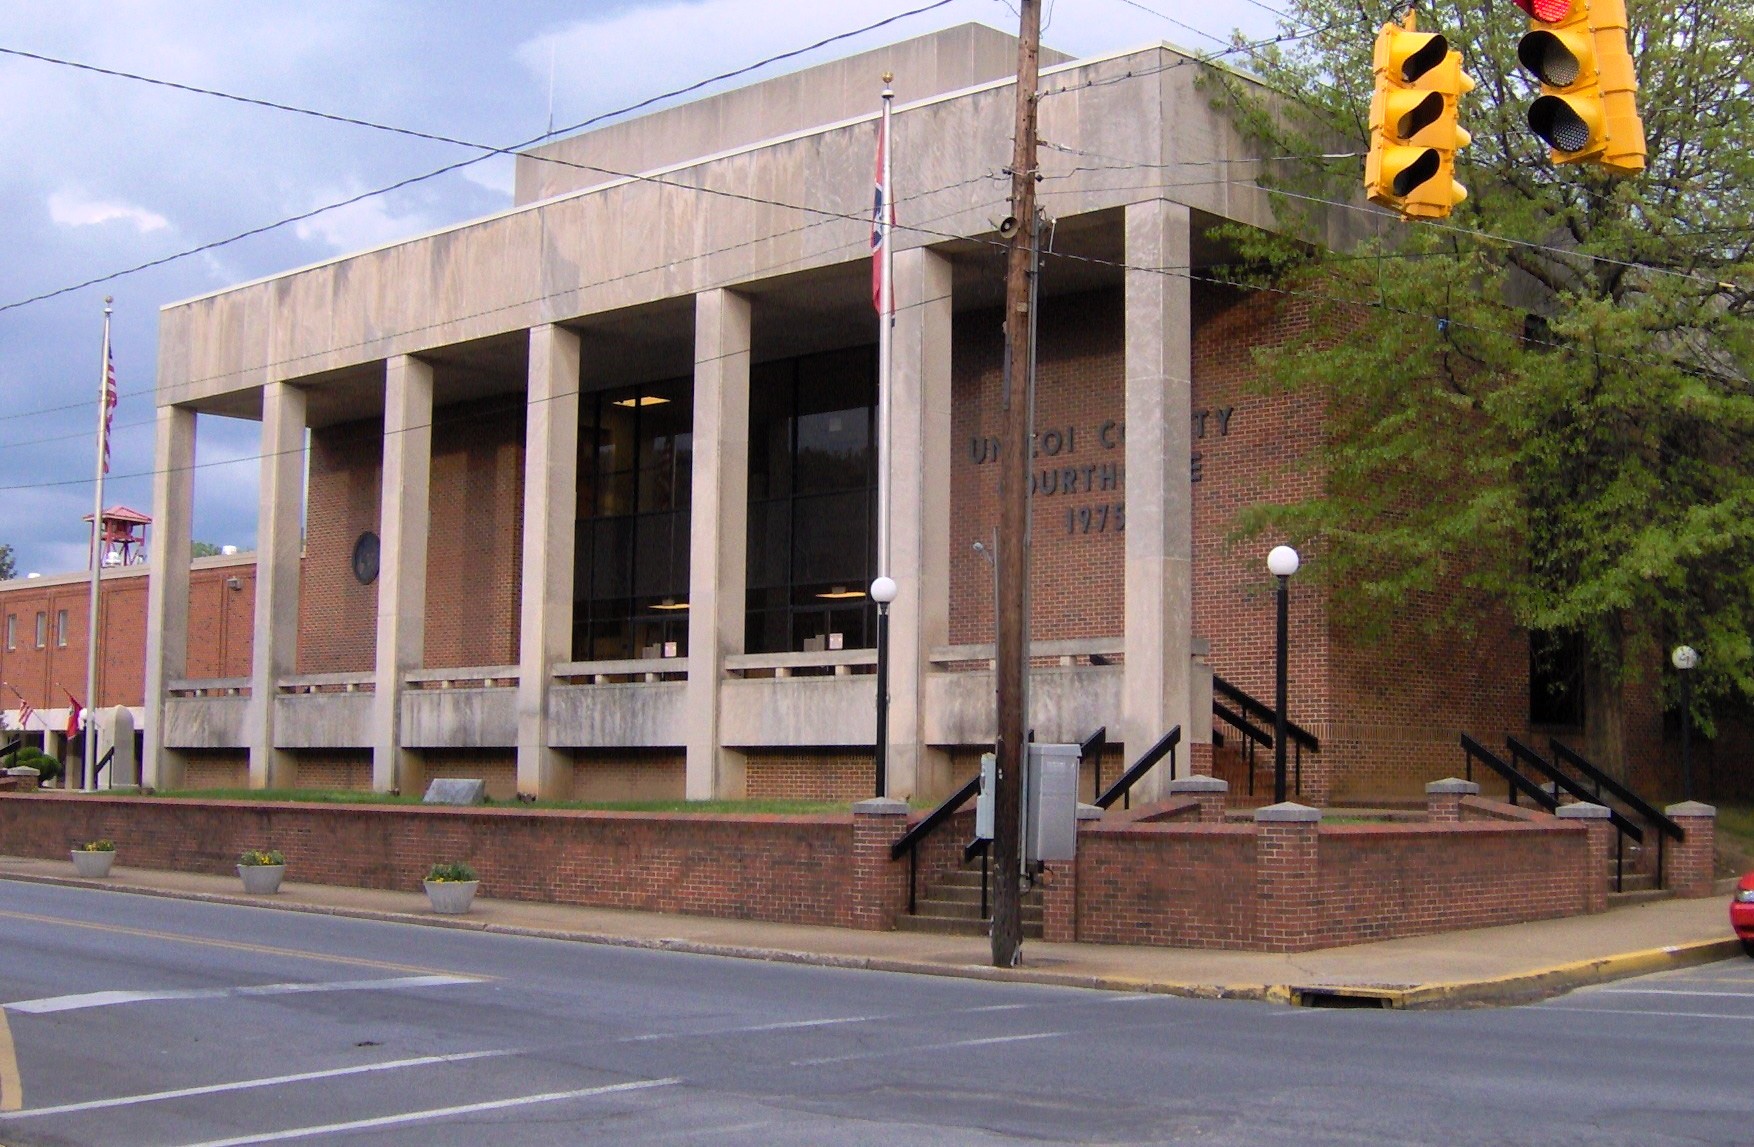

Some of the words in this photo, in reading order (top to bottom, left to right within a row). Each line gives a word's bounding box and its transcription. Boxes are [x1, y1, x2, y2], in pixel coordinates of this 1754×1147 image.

[968, 426, 1074, 464] UNCOI
[1098, 406, 1234, 449] CTY
[998, 451, 1202, 497] URTHE
